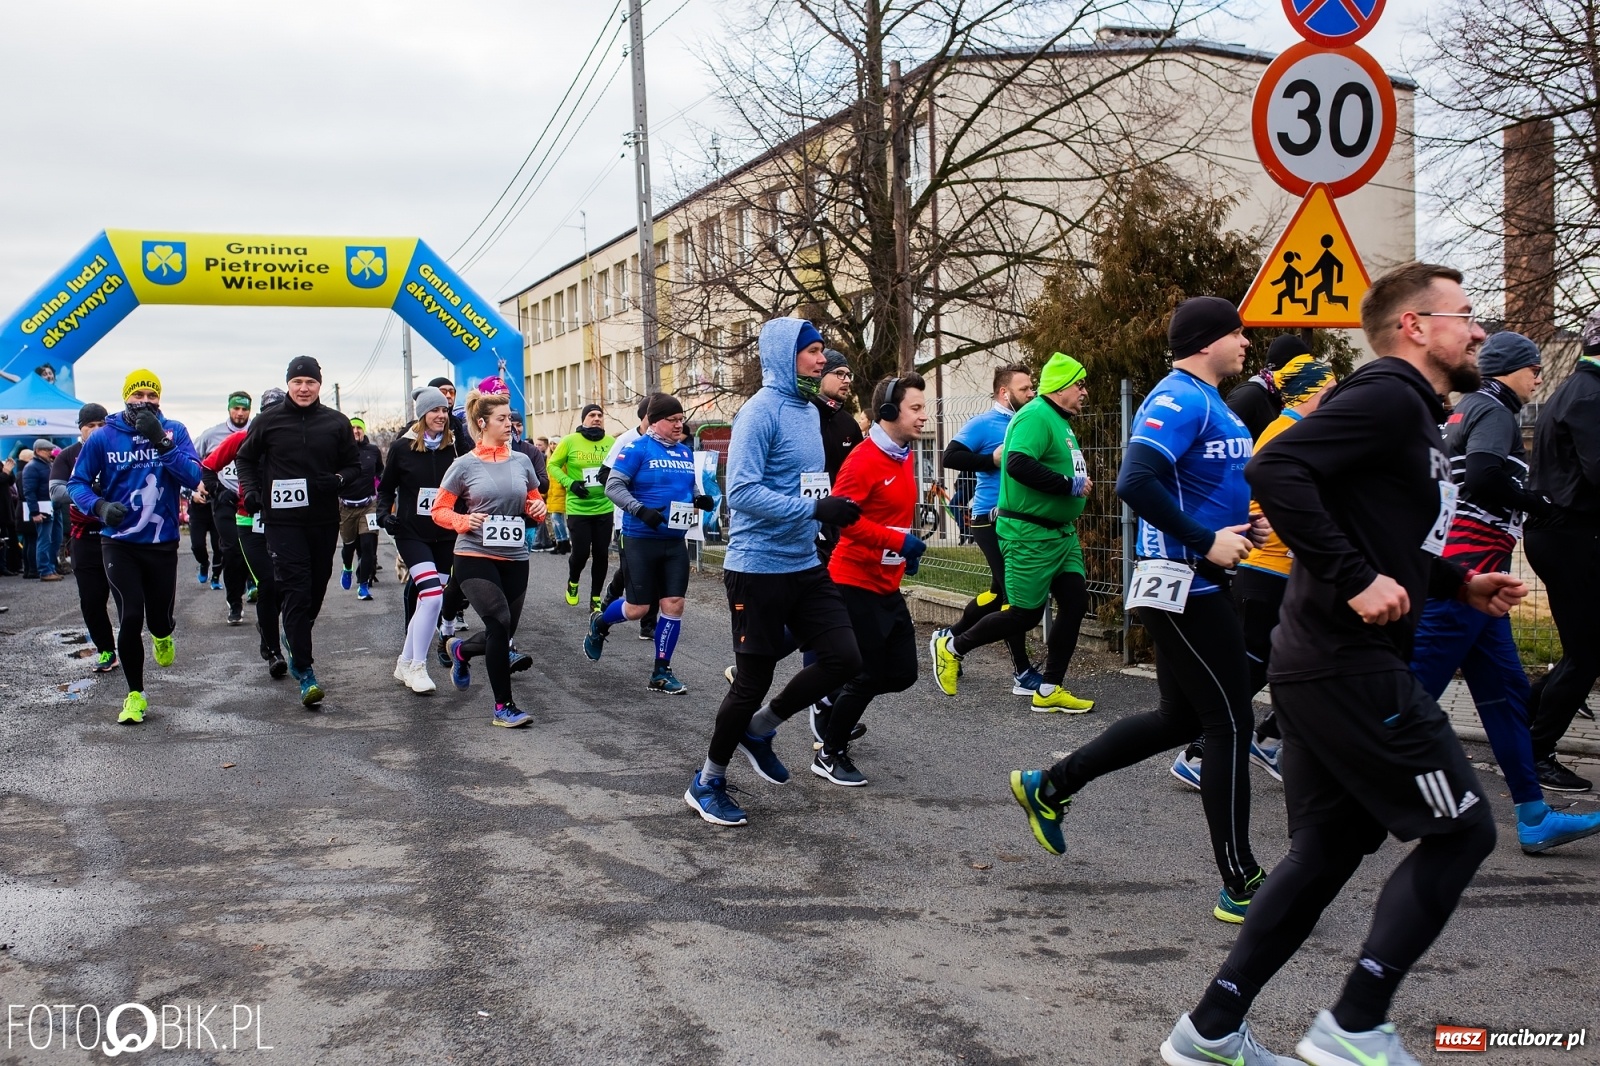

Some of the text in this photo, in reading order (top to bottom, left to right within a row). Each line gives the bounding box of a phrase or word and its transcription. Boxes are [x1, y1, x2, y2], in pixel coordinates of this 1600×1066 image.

[1277, 79, 1374, 158] 30
[226, 242, 308, 255] Gmina
[205, 257, 330, 274] Pietrowice
[221, 275, 314, 291] Wielkie
[21, 254, 108, 334] Gmina ludzi
[419, 264, 498, 339] Gmina ludzi
[42, 274, 123, 348] aktywnych
[406, 281, 481, 351] aktywnych
[273, 489, 305, 503] 320
[670, 511, 693, 525] 415
[486, 526, 523, 542] 269
[1133, 576, 1183, 602] 121
